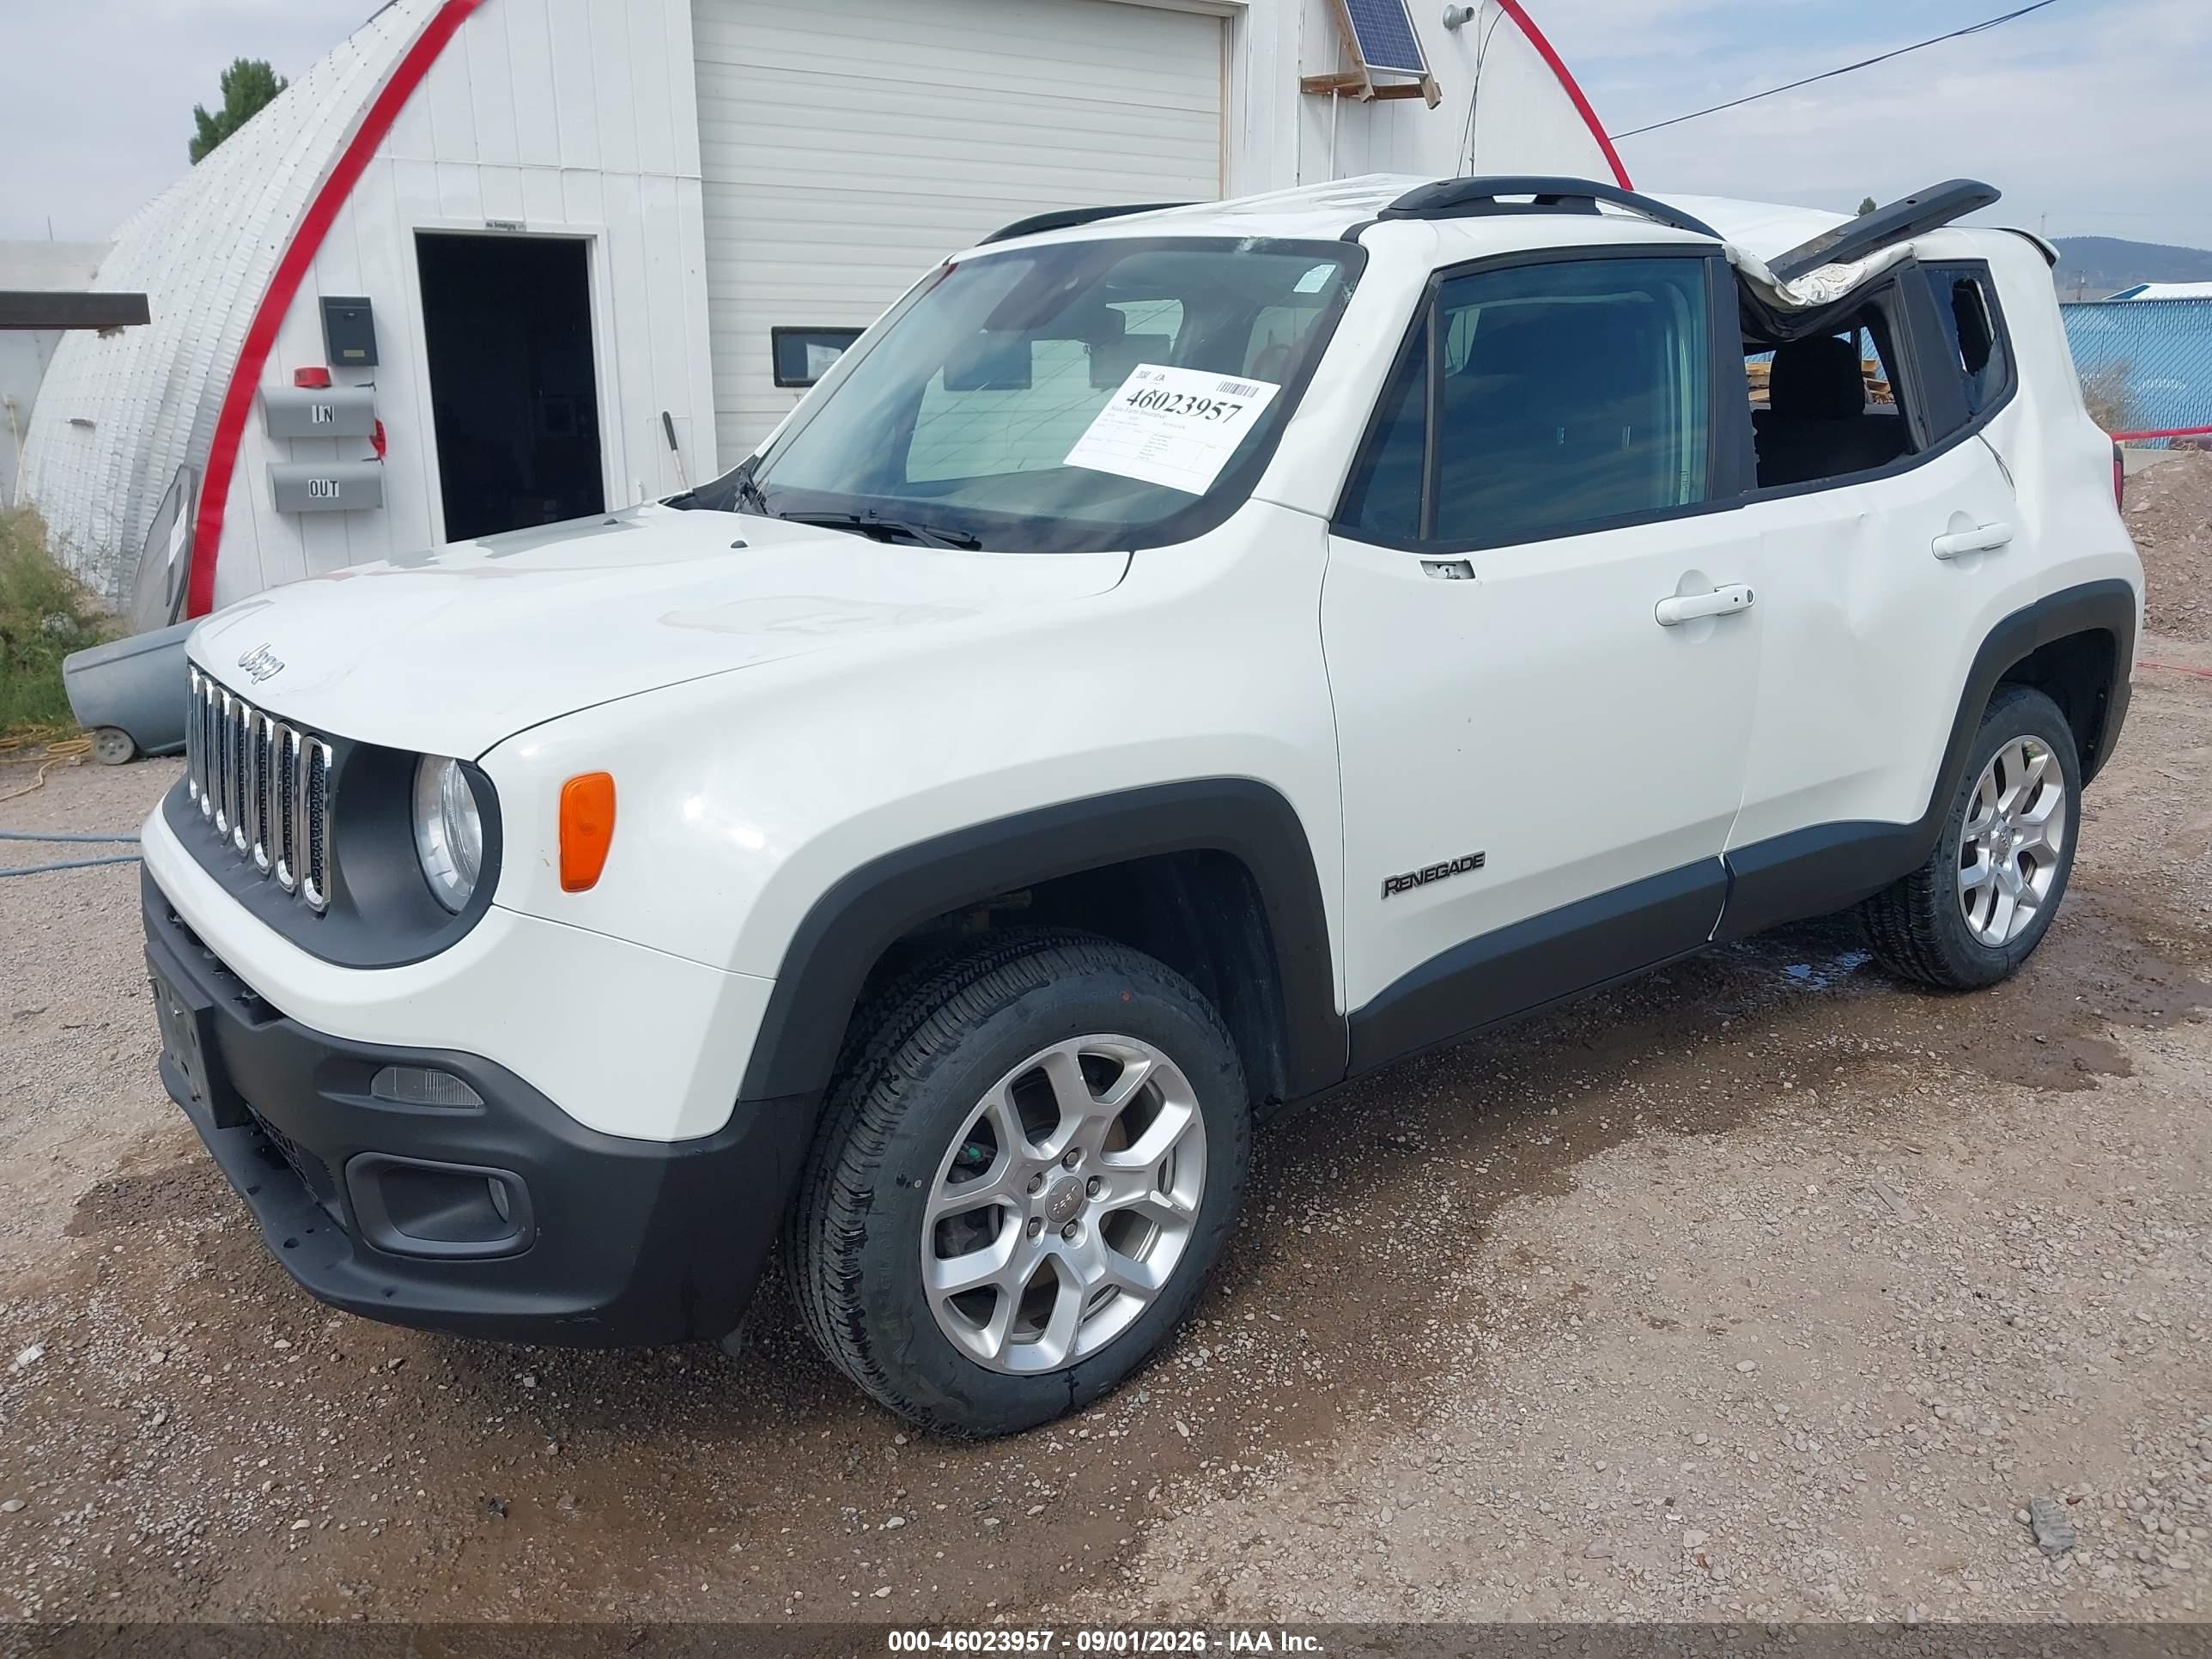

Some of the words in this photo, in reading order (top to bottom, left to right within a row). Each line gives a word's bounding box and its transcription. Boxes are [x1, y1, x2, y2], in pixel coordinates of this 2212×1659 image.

[315, 404, 334, 422] IN
[1126, 388, 1244, 424] 46023957
[310, 480, 338, 496] OUT
[238, 641, 286, 686] Jeep
[1381, 848, 1486, 900] RENEGADE
